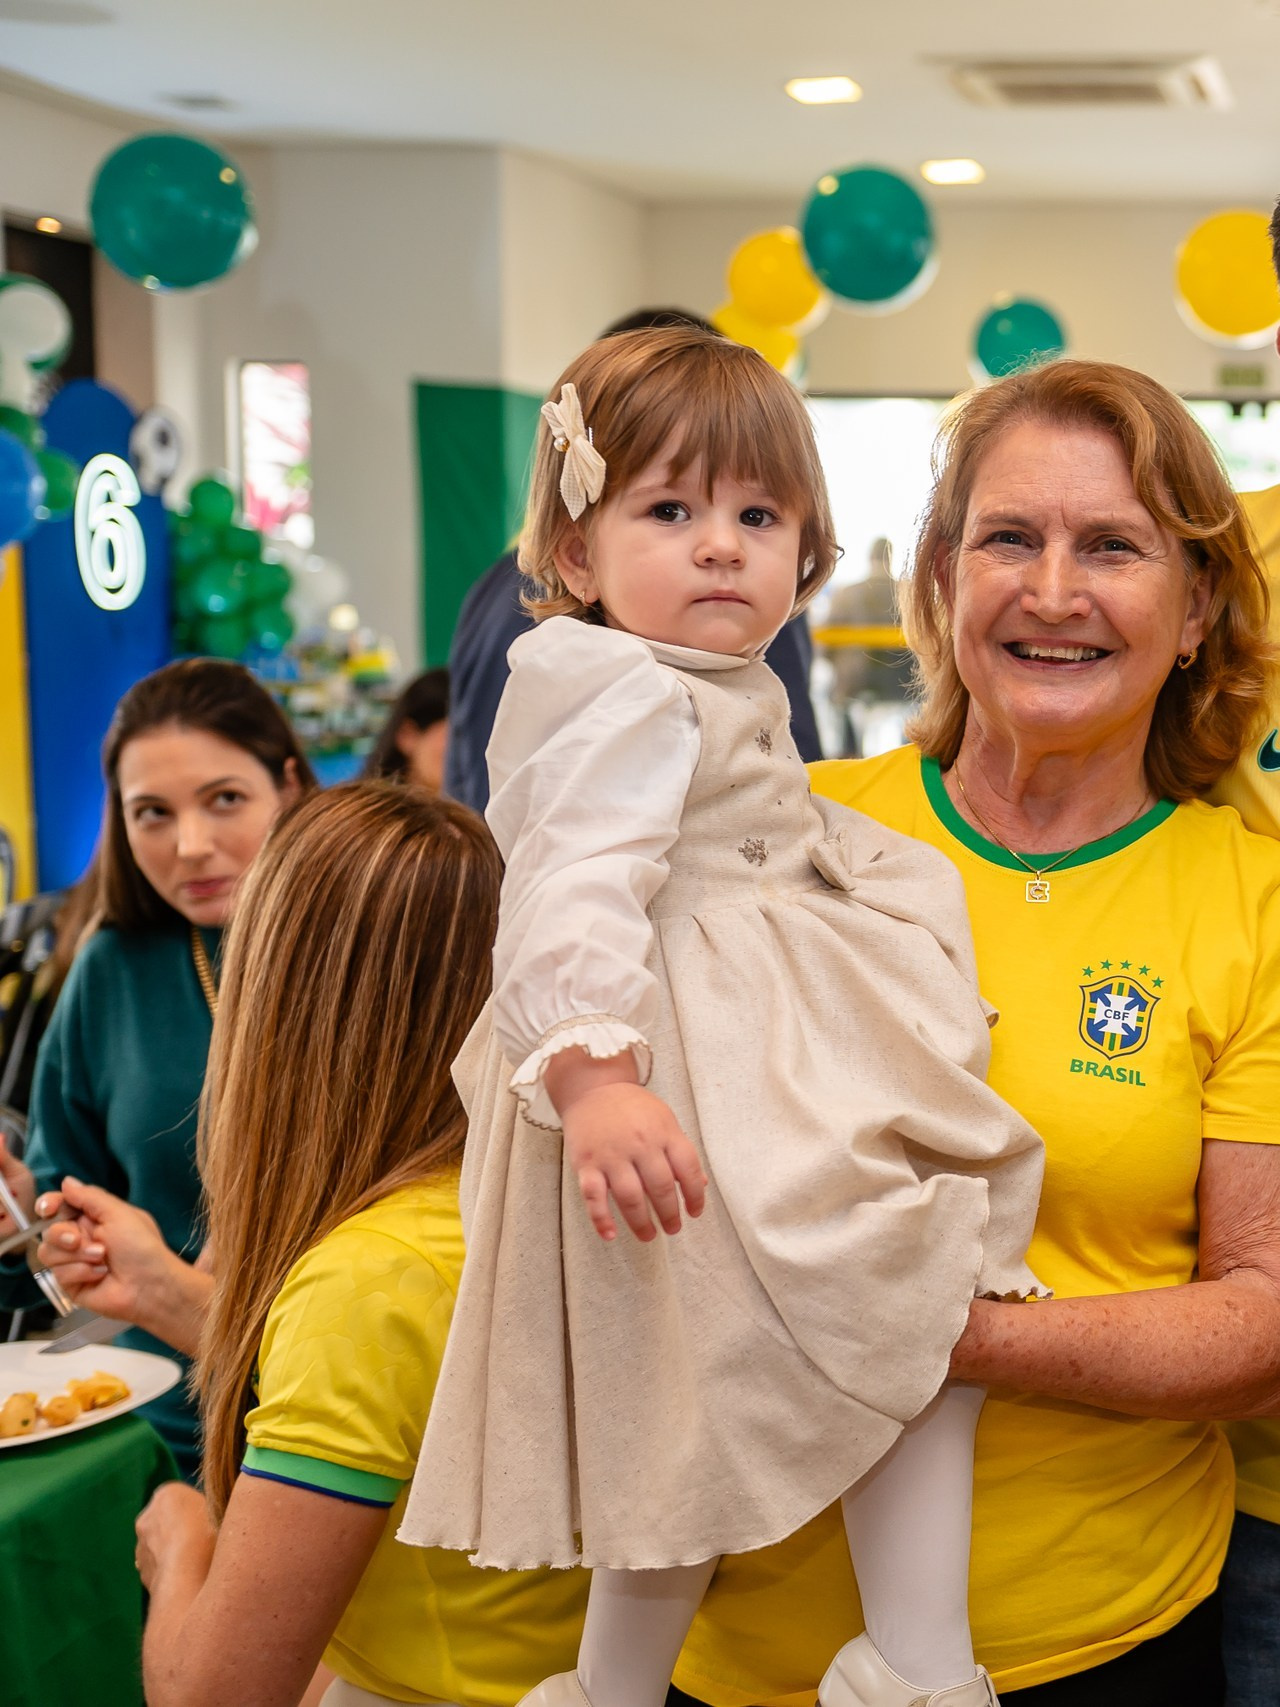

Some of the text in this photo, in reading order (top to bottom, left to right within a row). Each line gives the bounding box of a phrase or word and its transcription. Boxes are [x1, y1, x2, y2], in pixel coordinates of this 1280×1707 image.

[74, 453, 147, 611] 6
[1103, 1008, 1130, 1022] CBF
[1069, 1058, 1146, 1087] BRASIL
